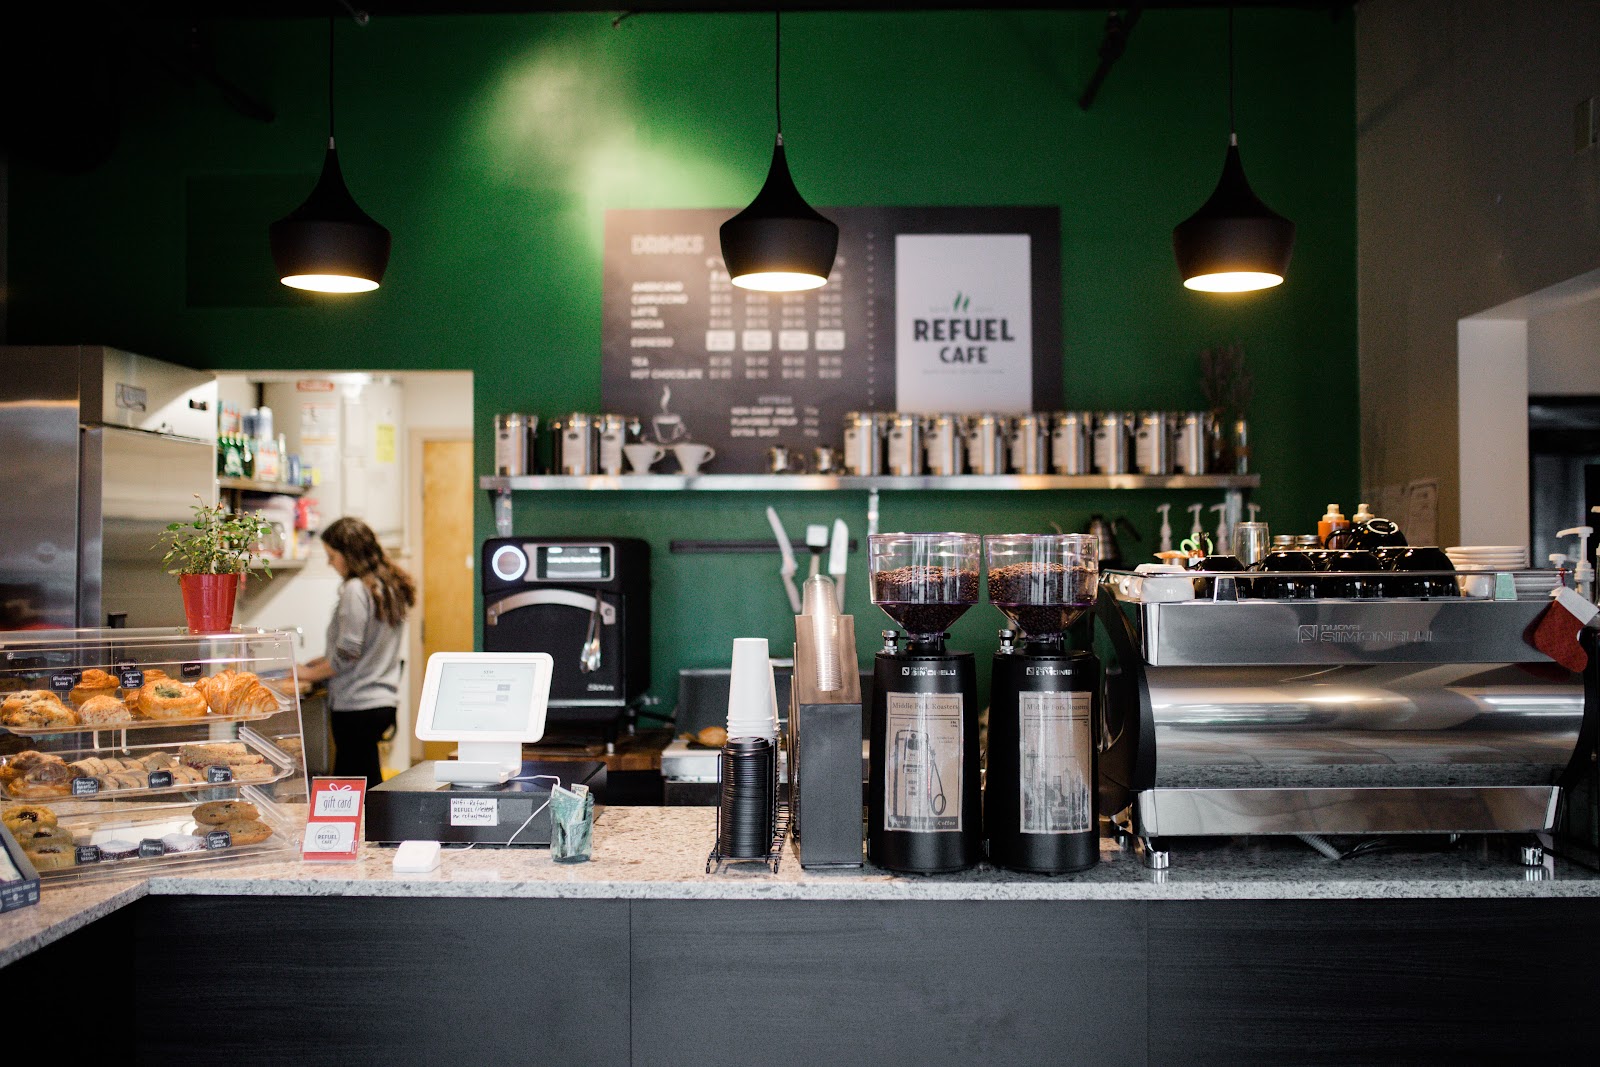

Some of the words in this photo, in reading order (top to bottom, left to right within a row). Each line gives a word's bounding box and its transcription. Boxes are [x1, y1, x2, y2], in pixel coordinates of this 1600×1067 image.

[632, 281, 683, 292] AMERICANO
[631, 293, 688, 305] CAPPUCCINO
[631, 306, 658, 317] LATTE
[631, 318, 664, 329] MOCHA
[913, 318, 1015, 342] REFUEL
[939, 346, 988, 364] CAFE
[632, 357, 649, 367] TEA
[630, 369, 650, 379] HOT
[651, 369, 703, 379] CHOCOLATE
[1321, 631, 1432, 642] SIMONELLI
[892, 702, 912, 711] Middle
[324, 796, 336, 811] gift
[337, 796, 352, 809] card
